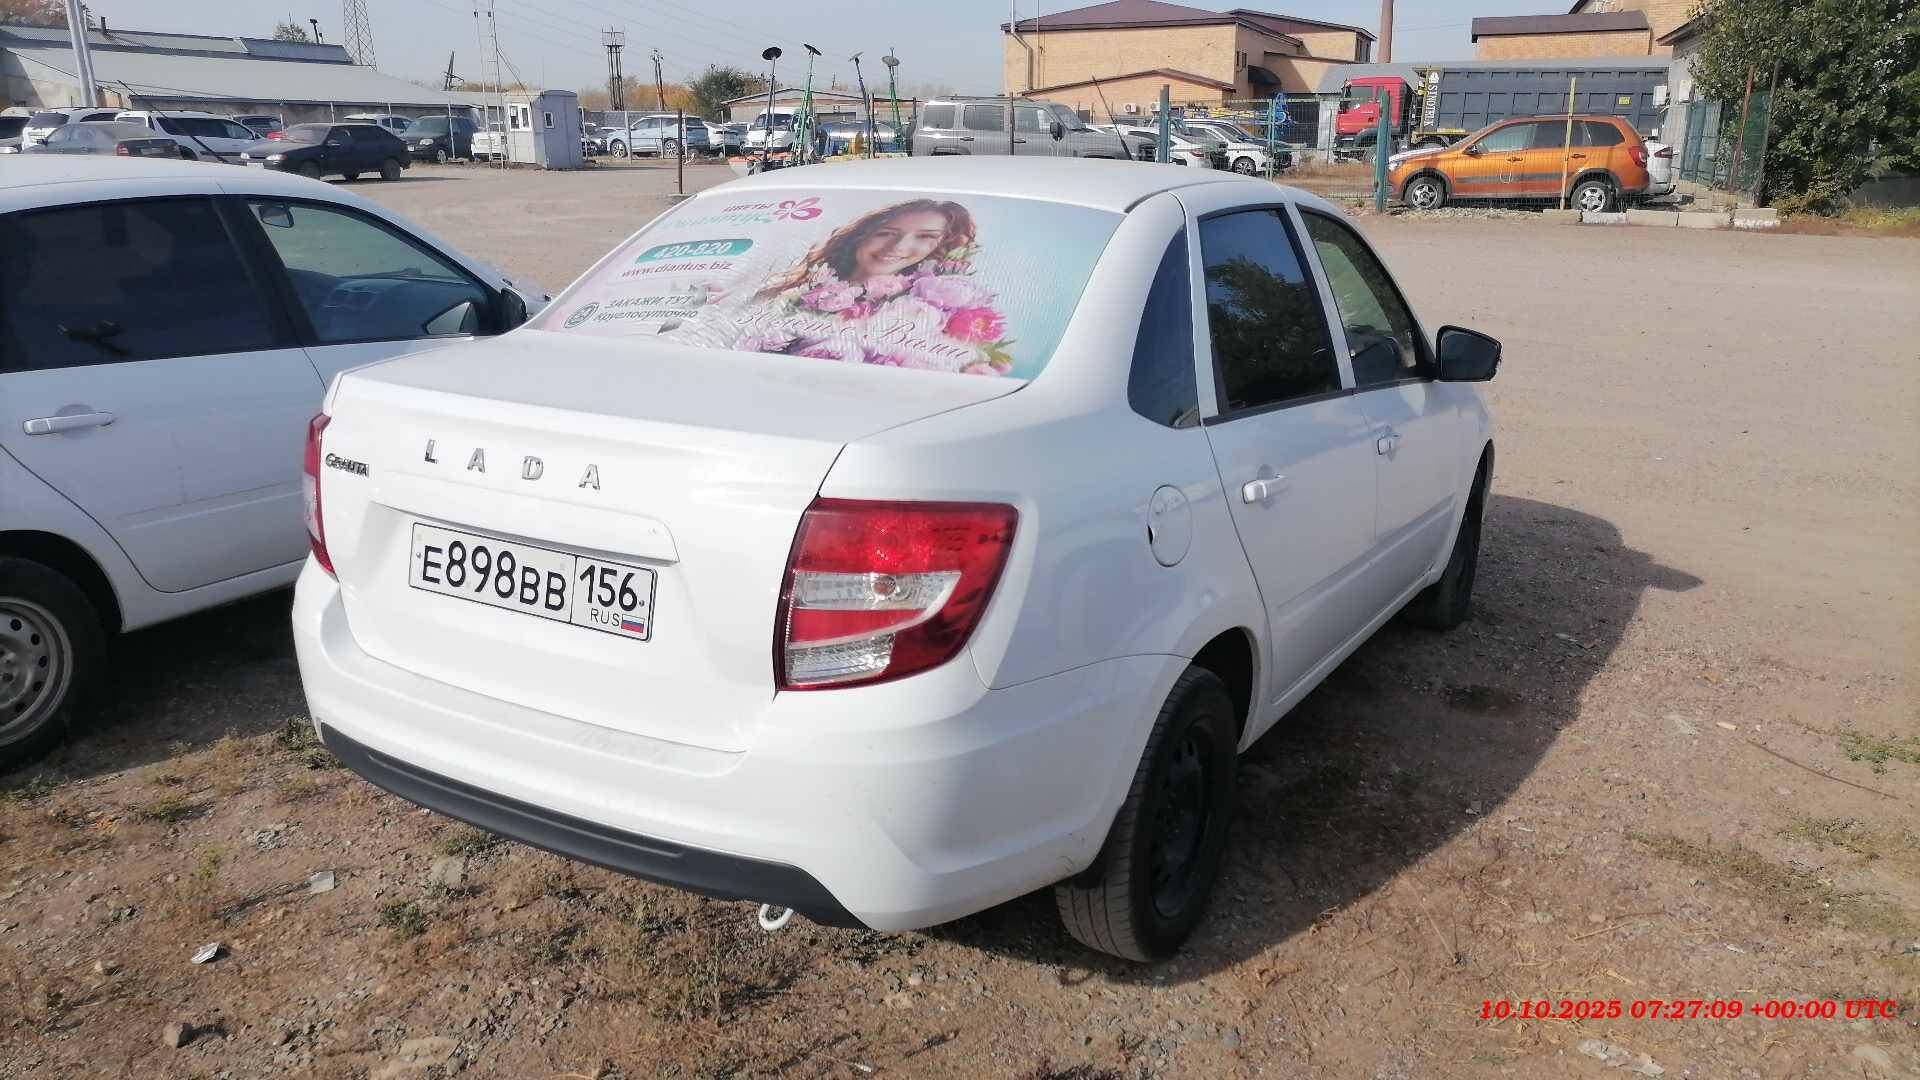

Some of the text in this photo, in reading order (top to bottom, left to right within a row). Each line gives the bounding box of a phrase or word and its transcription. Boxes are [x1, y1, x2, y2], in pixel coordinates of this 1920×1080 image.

[424, 438, 601, 491] LADA
[422, 540, 638, 612] Е898ВВ 156
[590, 608, 620, 628] RUS
